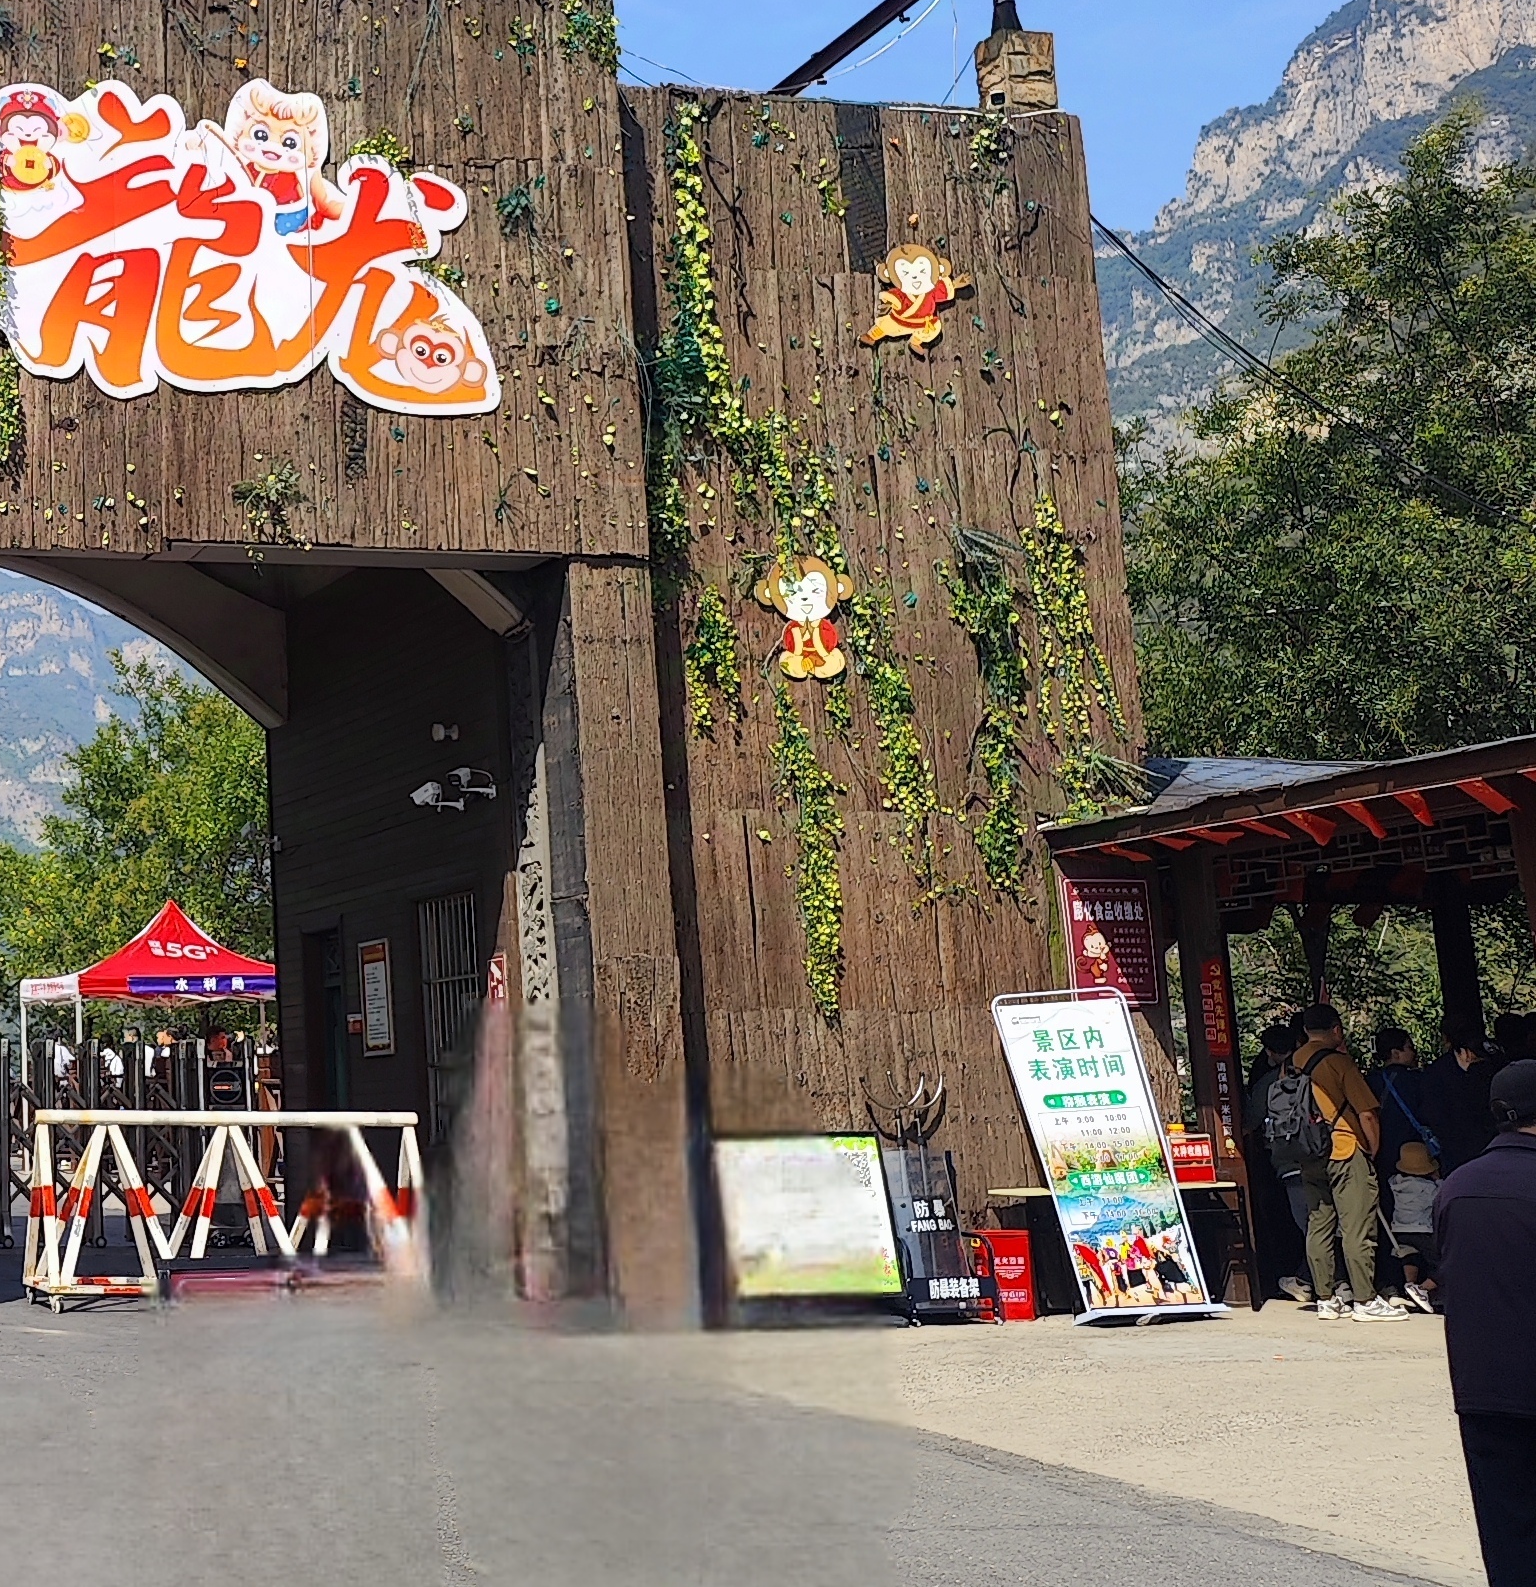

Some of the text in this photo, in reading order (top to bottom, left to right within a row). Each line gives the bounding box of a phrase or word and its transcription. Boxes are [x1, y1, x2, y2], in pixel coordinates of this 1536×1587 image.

[174, 976, 245, 993] 水利局
[1031, 1025, 1105, 1053] 景区内
[1027, 1054, 1126, 1081] 表演时间
[1104, 1113, 1127, 1122] 10:00
[913, 1199, 946, 1218] 防暴
[910, 1219, 937, 1233] FANG
[928, 1277, 981, 1300] 防暴装备架
